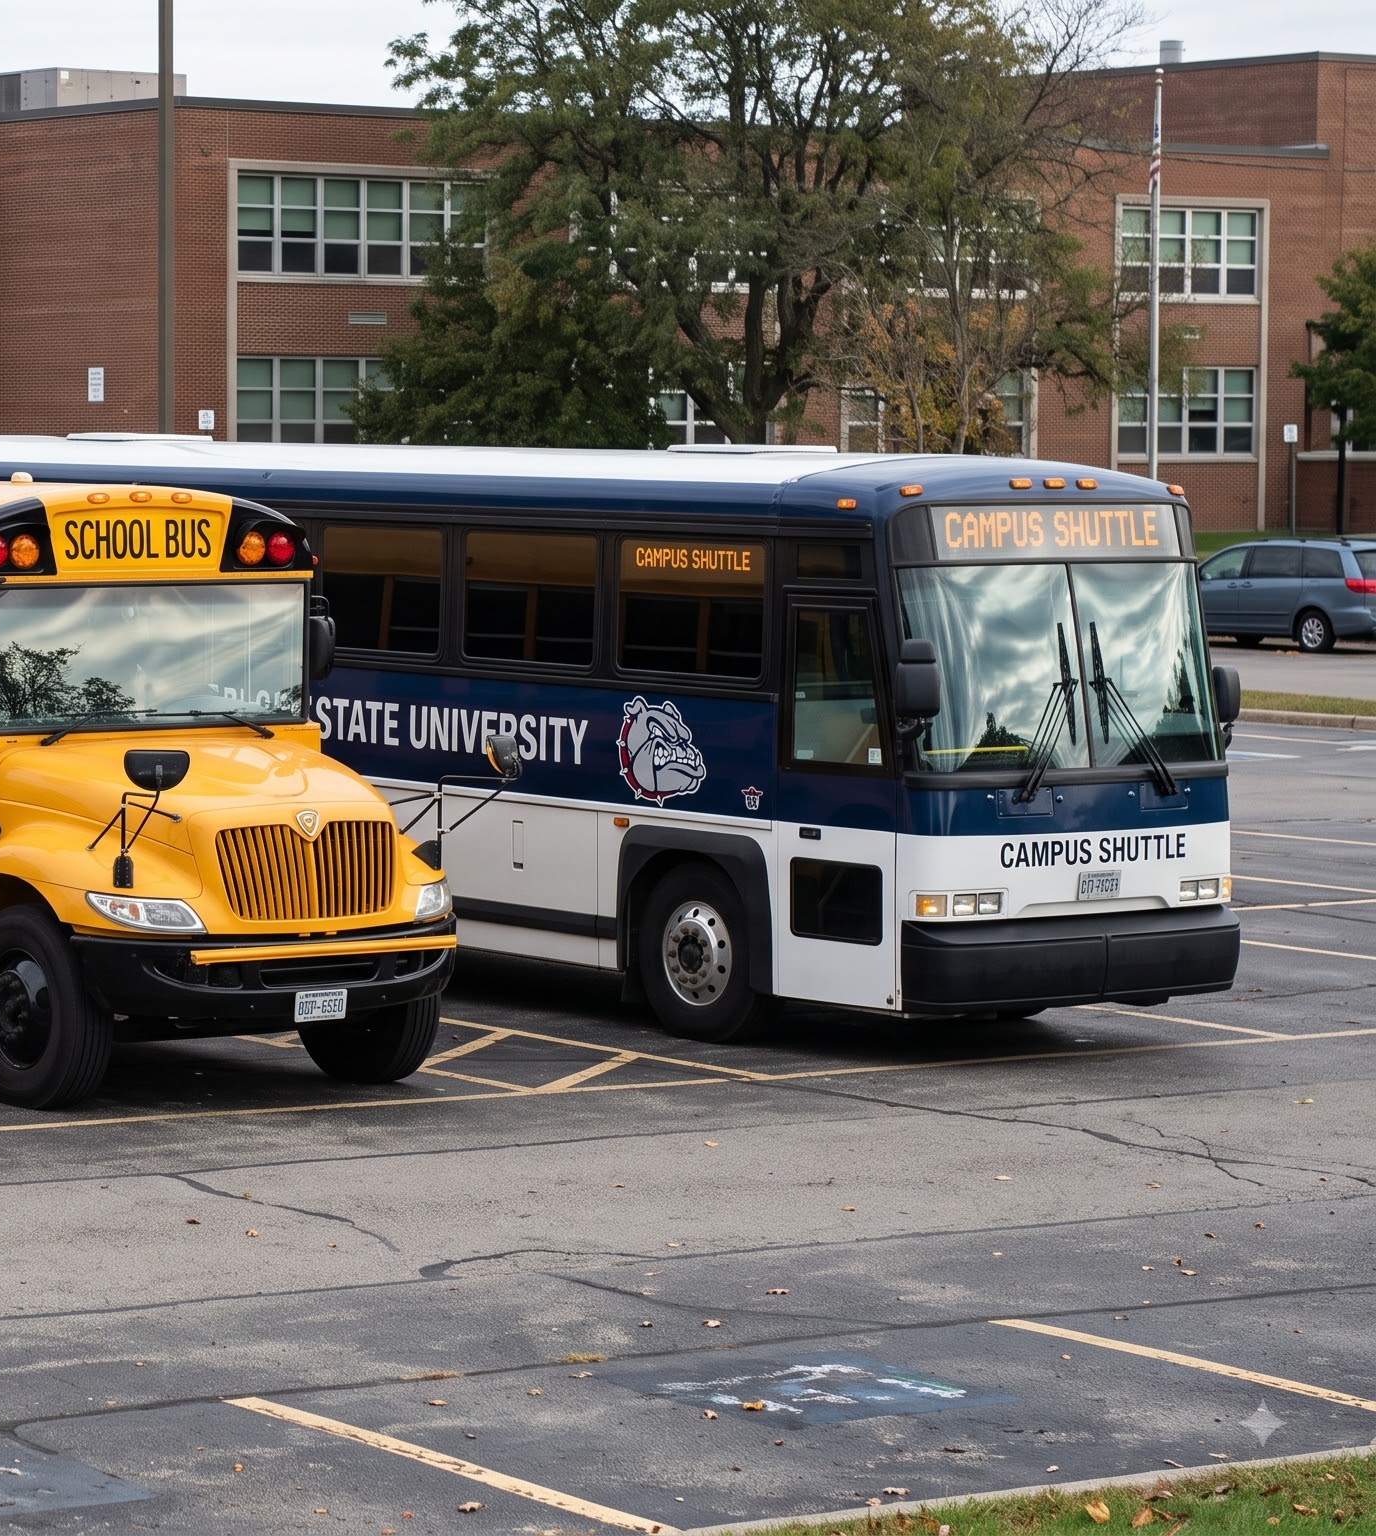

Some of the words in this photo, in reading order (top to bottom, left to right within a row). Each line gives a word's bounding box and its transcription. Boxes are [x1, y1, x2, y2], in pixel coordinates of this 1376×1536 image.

[64, 519, 159, 560] SCHOOL
[165, 518, 211, 559] BUS
[944, 510, 1044, 548] CAMPUS
[1053, 510, 1159, 547] SHUTTLE
[636, 547, 688, 569] CAMPUS
[692, 550, 751, 571] SHUTTLE
[316, 696, 400, 746] STATE
[1000, 838, 1092, 868] CAMPUS
[1099, 833, 1186, 863] SHUTTLE
